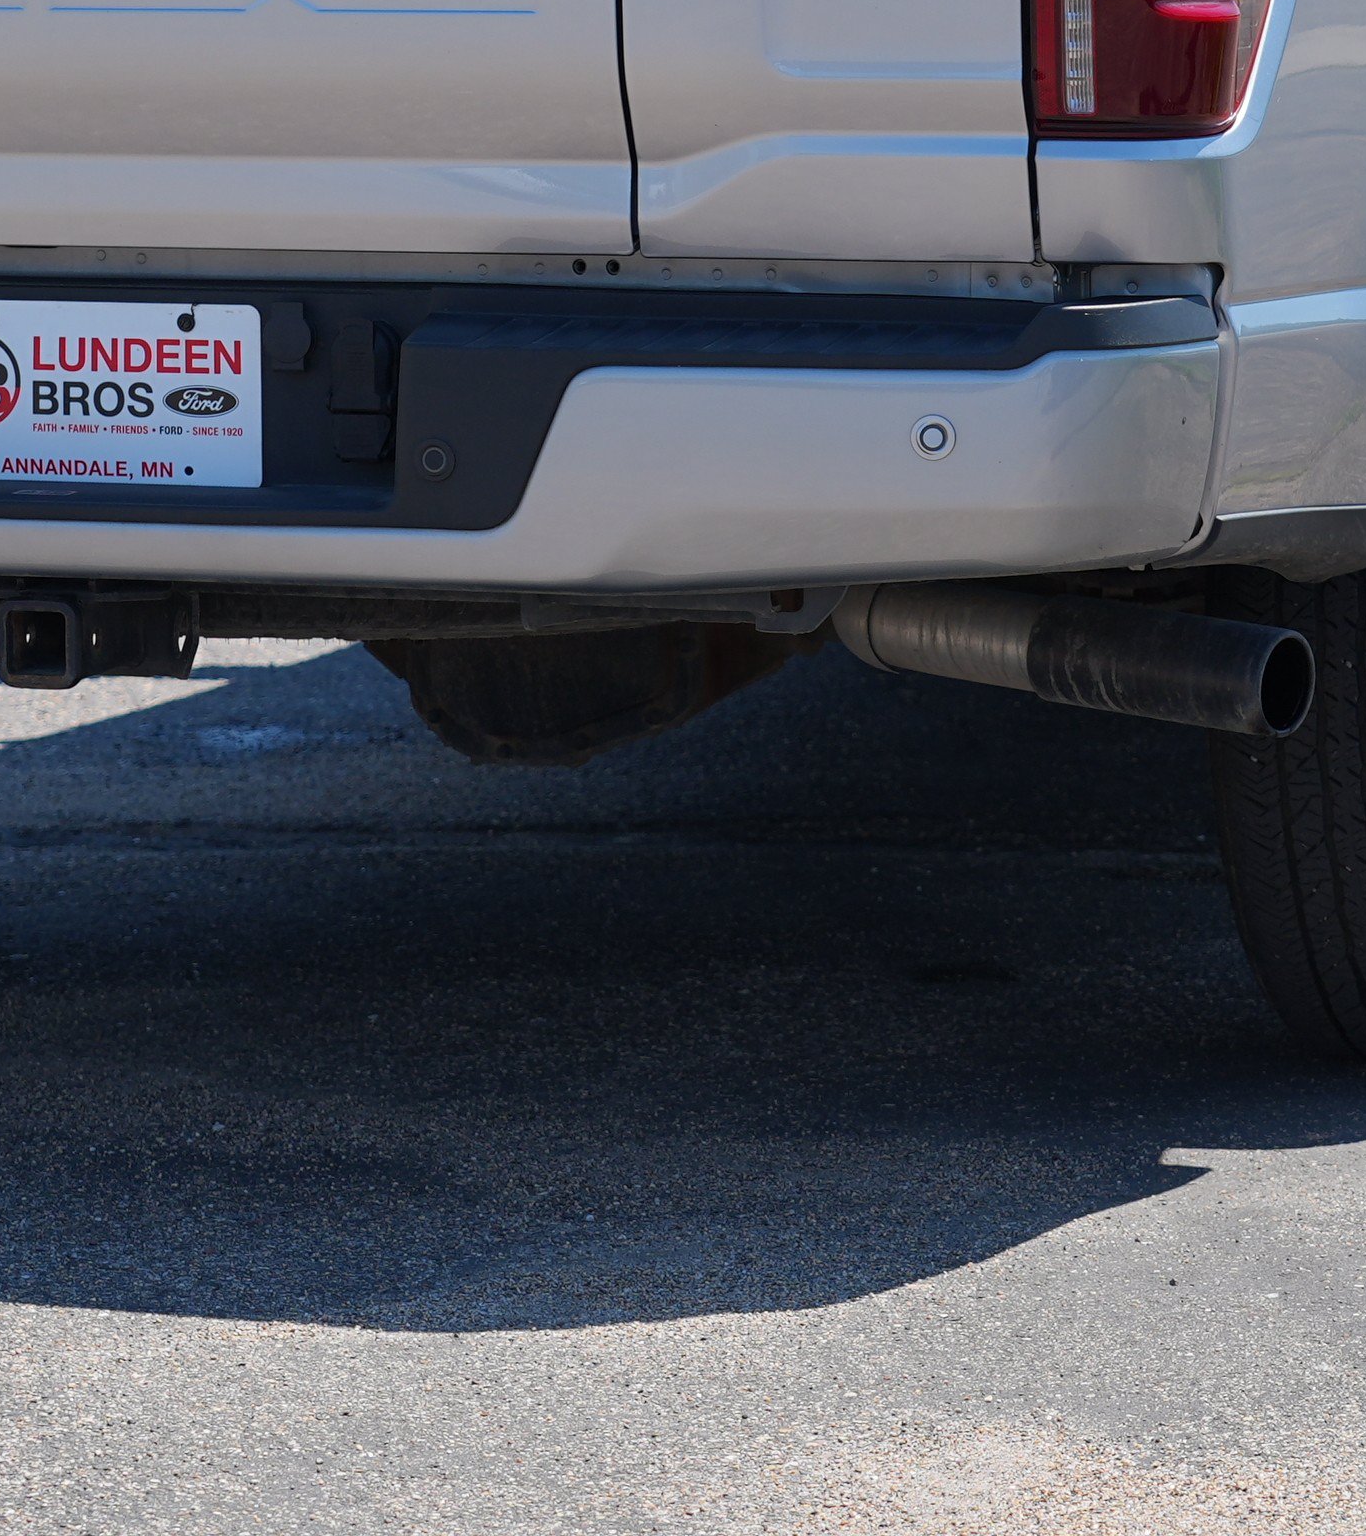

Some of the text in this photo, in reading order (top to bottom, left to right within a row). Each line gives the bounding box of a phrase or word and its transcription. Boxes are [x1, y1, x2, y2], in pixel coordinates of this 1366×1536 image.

[32, 336, 242, 375] LUNDEEN
[32, 379, 225, 418] BROS Ford
[32, 423, 243, 437] FAITH FAMILY FRIENDS FORD SINCE 1920
[1, 456, 174, 480] ANNANDALE, MN
